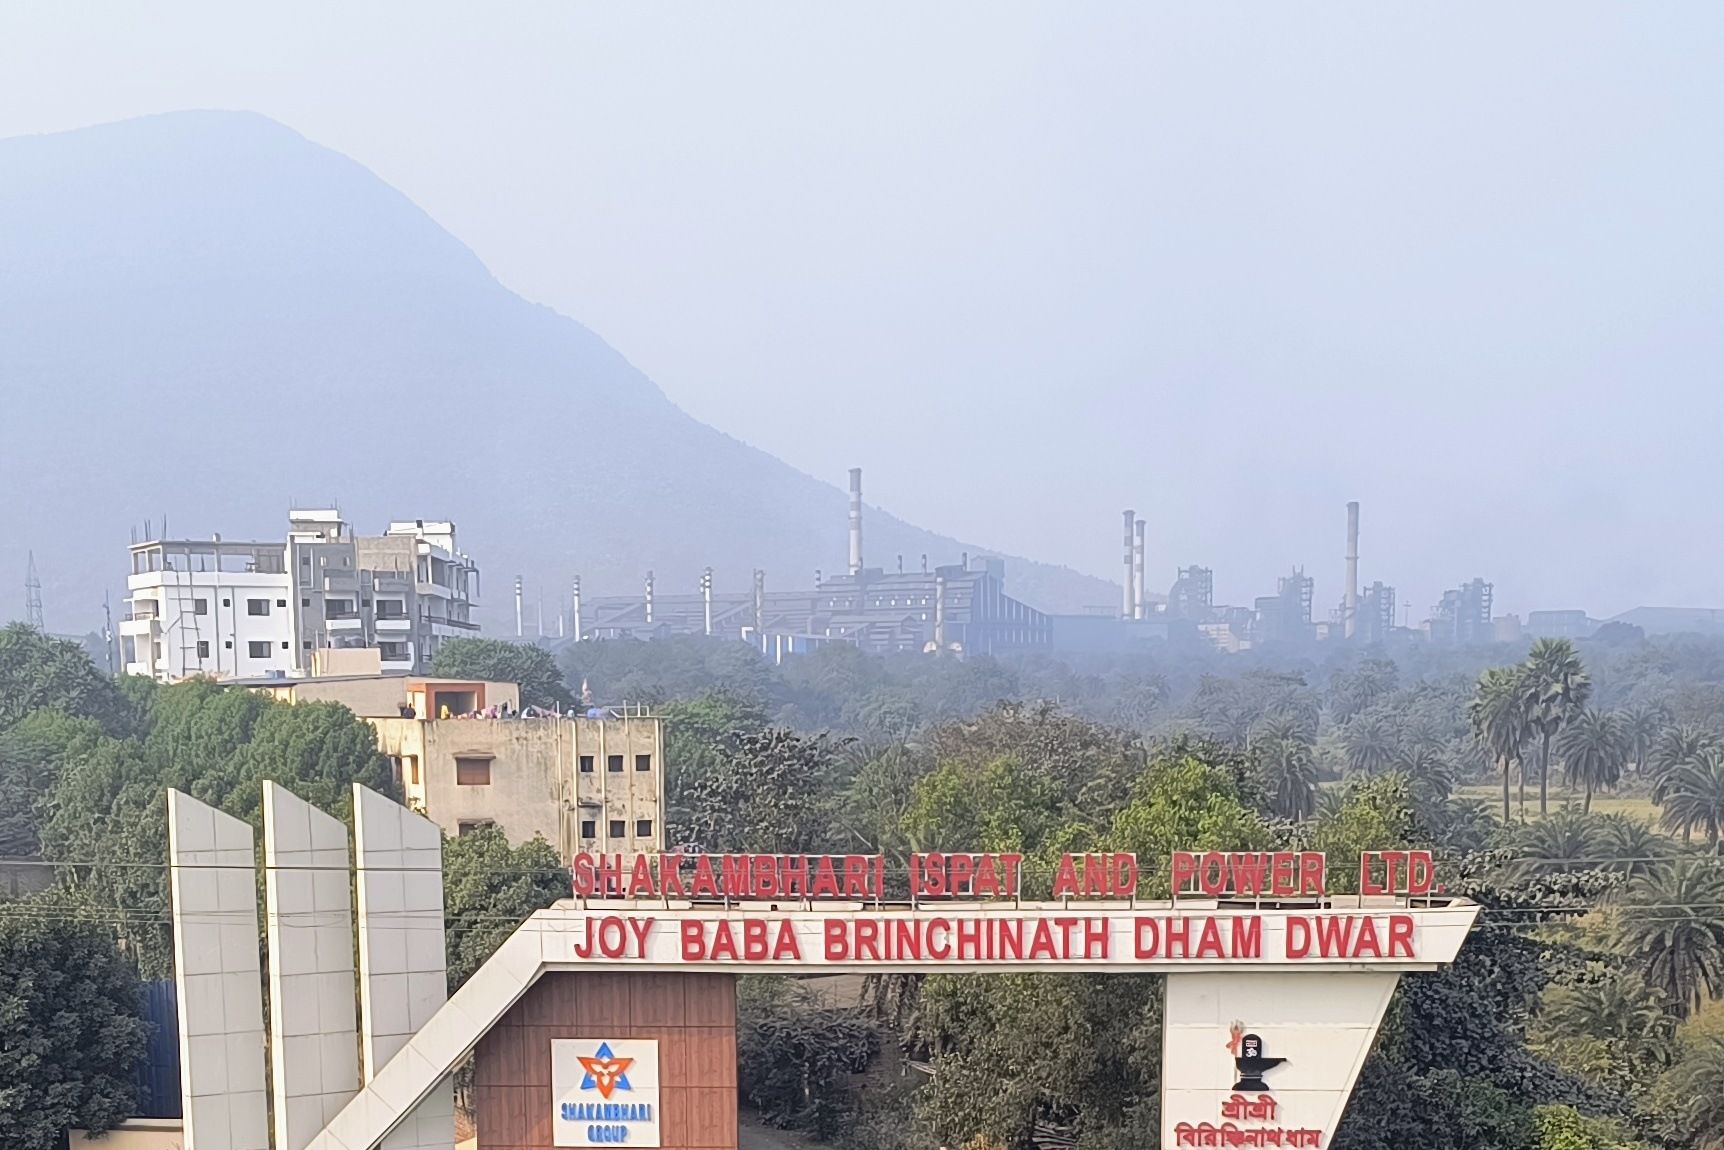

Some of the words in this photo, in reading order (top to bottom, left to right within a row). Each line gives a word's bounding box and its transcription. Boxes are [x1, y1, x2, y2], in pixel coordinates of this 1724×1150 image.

[573, 852, 885, 897] SHAKAMBHARI
[911, 852, 1022, 897] ISPAT
[1053, 852, 1138, 897] AND
[1172, 851, 1325, 896] POWER
[1361, 851, 1446, 896] LTD.
[574, 916, 655, 959] JOY
[681, 917, 801, 962] BABA
[824, 917, 1110, 961] BRINCHINATH
[1134, 915, 1263, 961] DHAM
[1285, 914, 1416, 959] DWAR
[587, 1125, 629, 1143] GROUP
